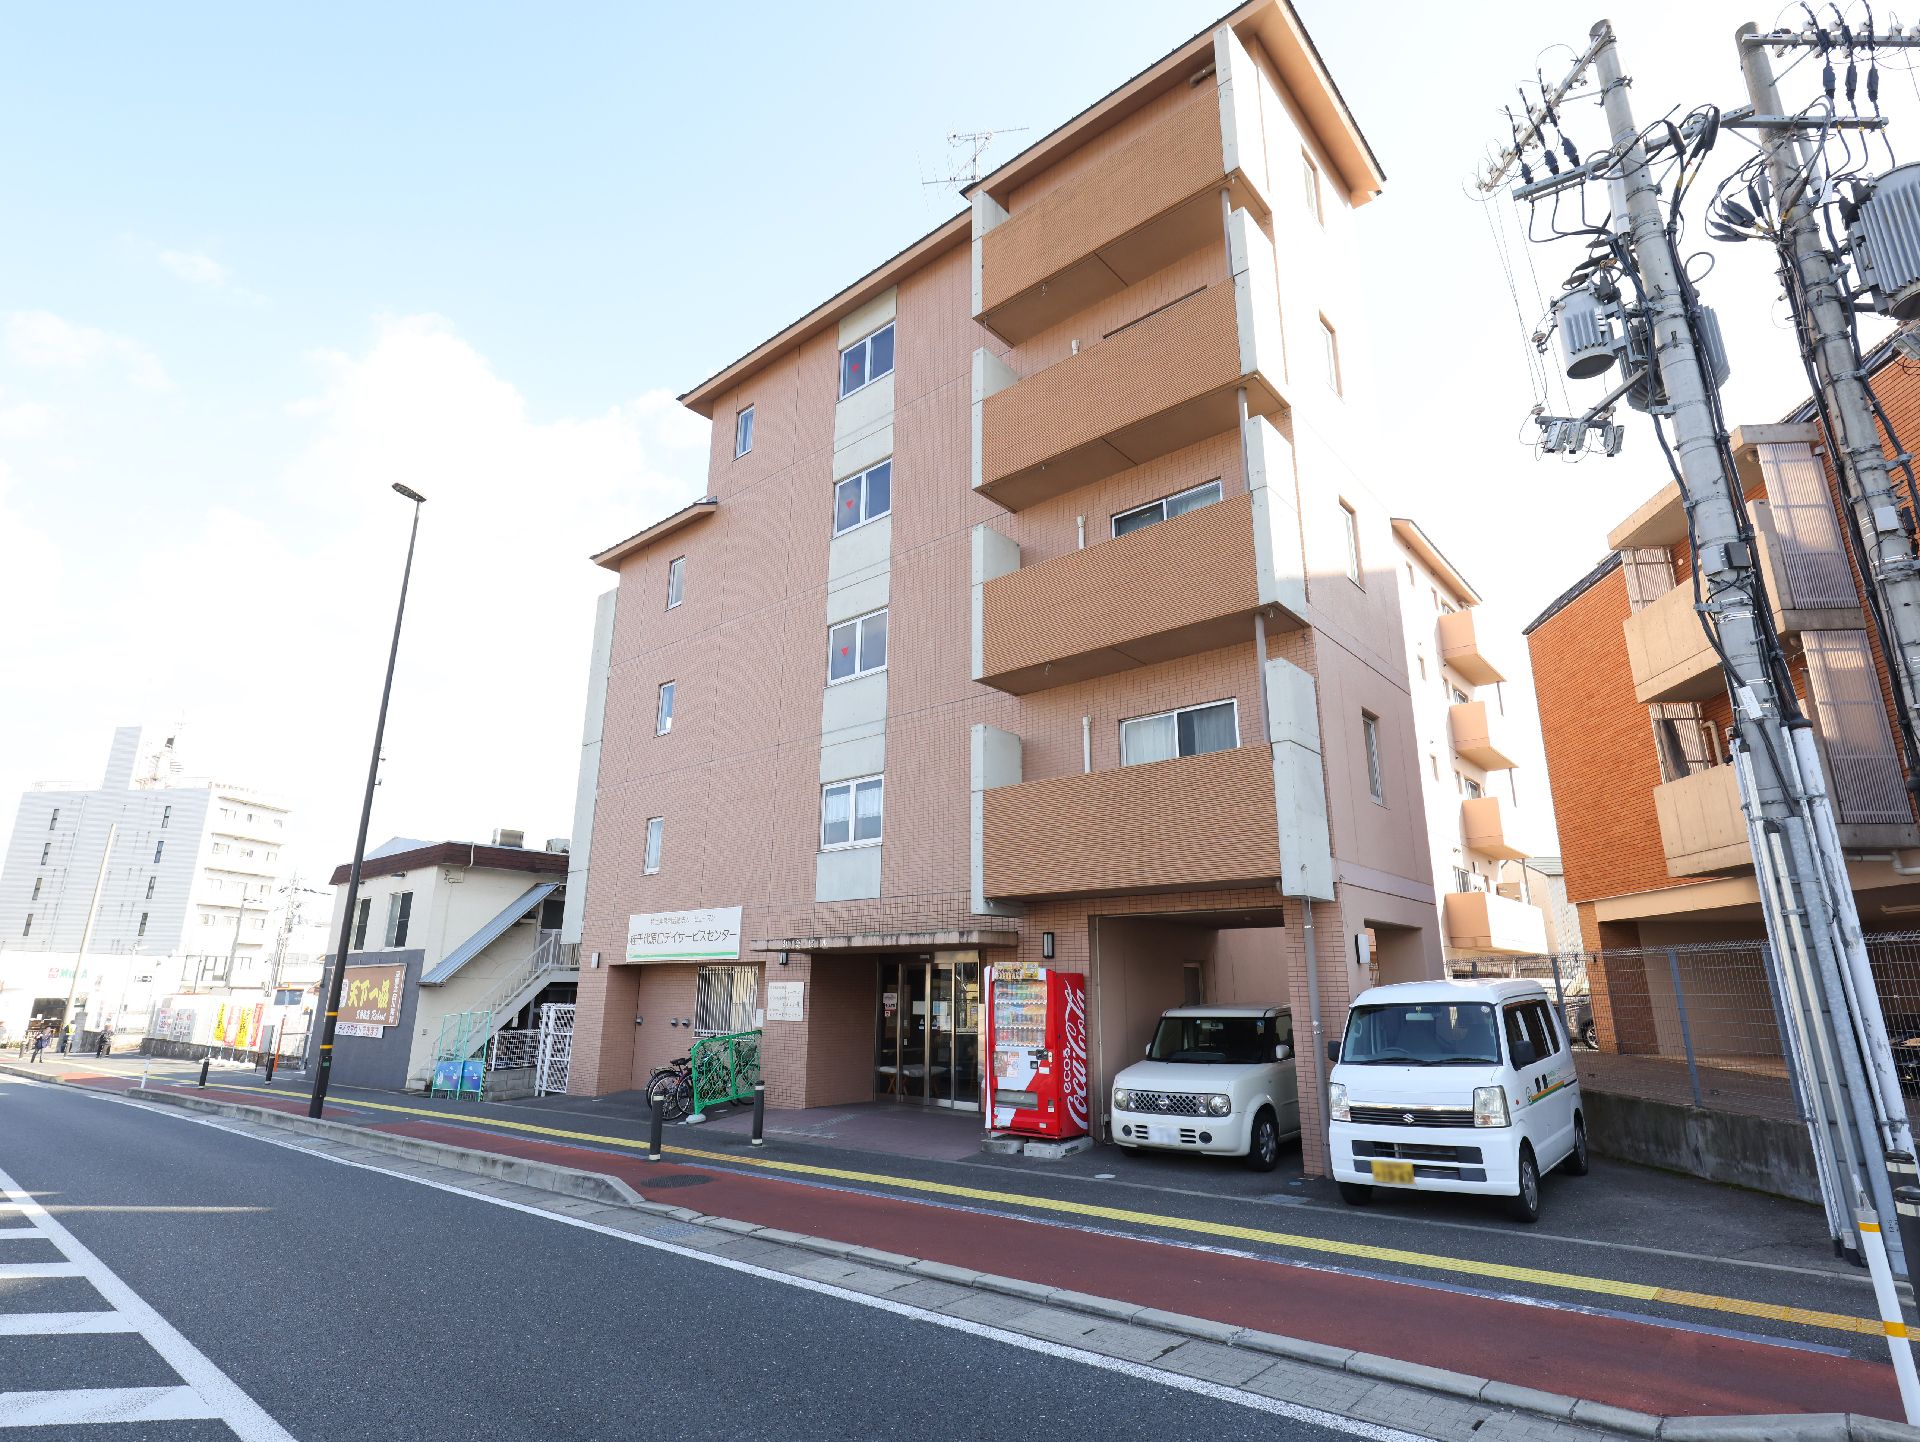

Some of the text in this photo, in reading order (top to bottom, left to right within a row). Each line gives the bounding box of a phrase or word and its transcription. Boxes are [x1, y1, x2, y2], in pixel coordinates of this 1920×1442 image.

[348, 979, 390, 1009] 天下一品
[1064, 977, 1088, 1130] Coca-Cola
